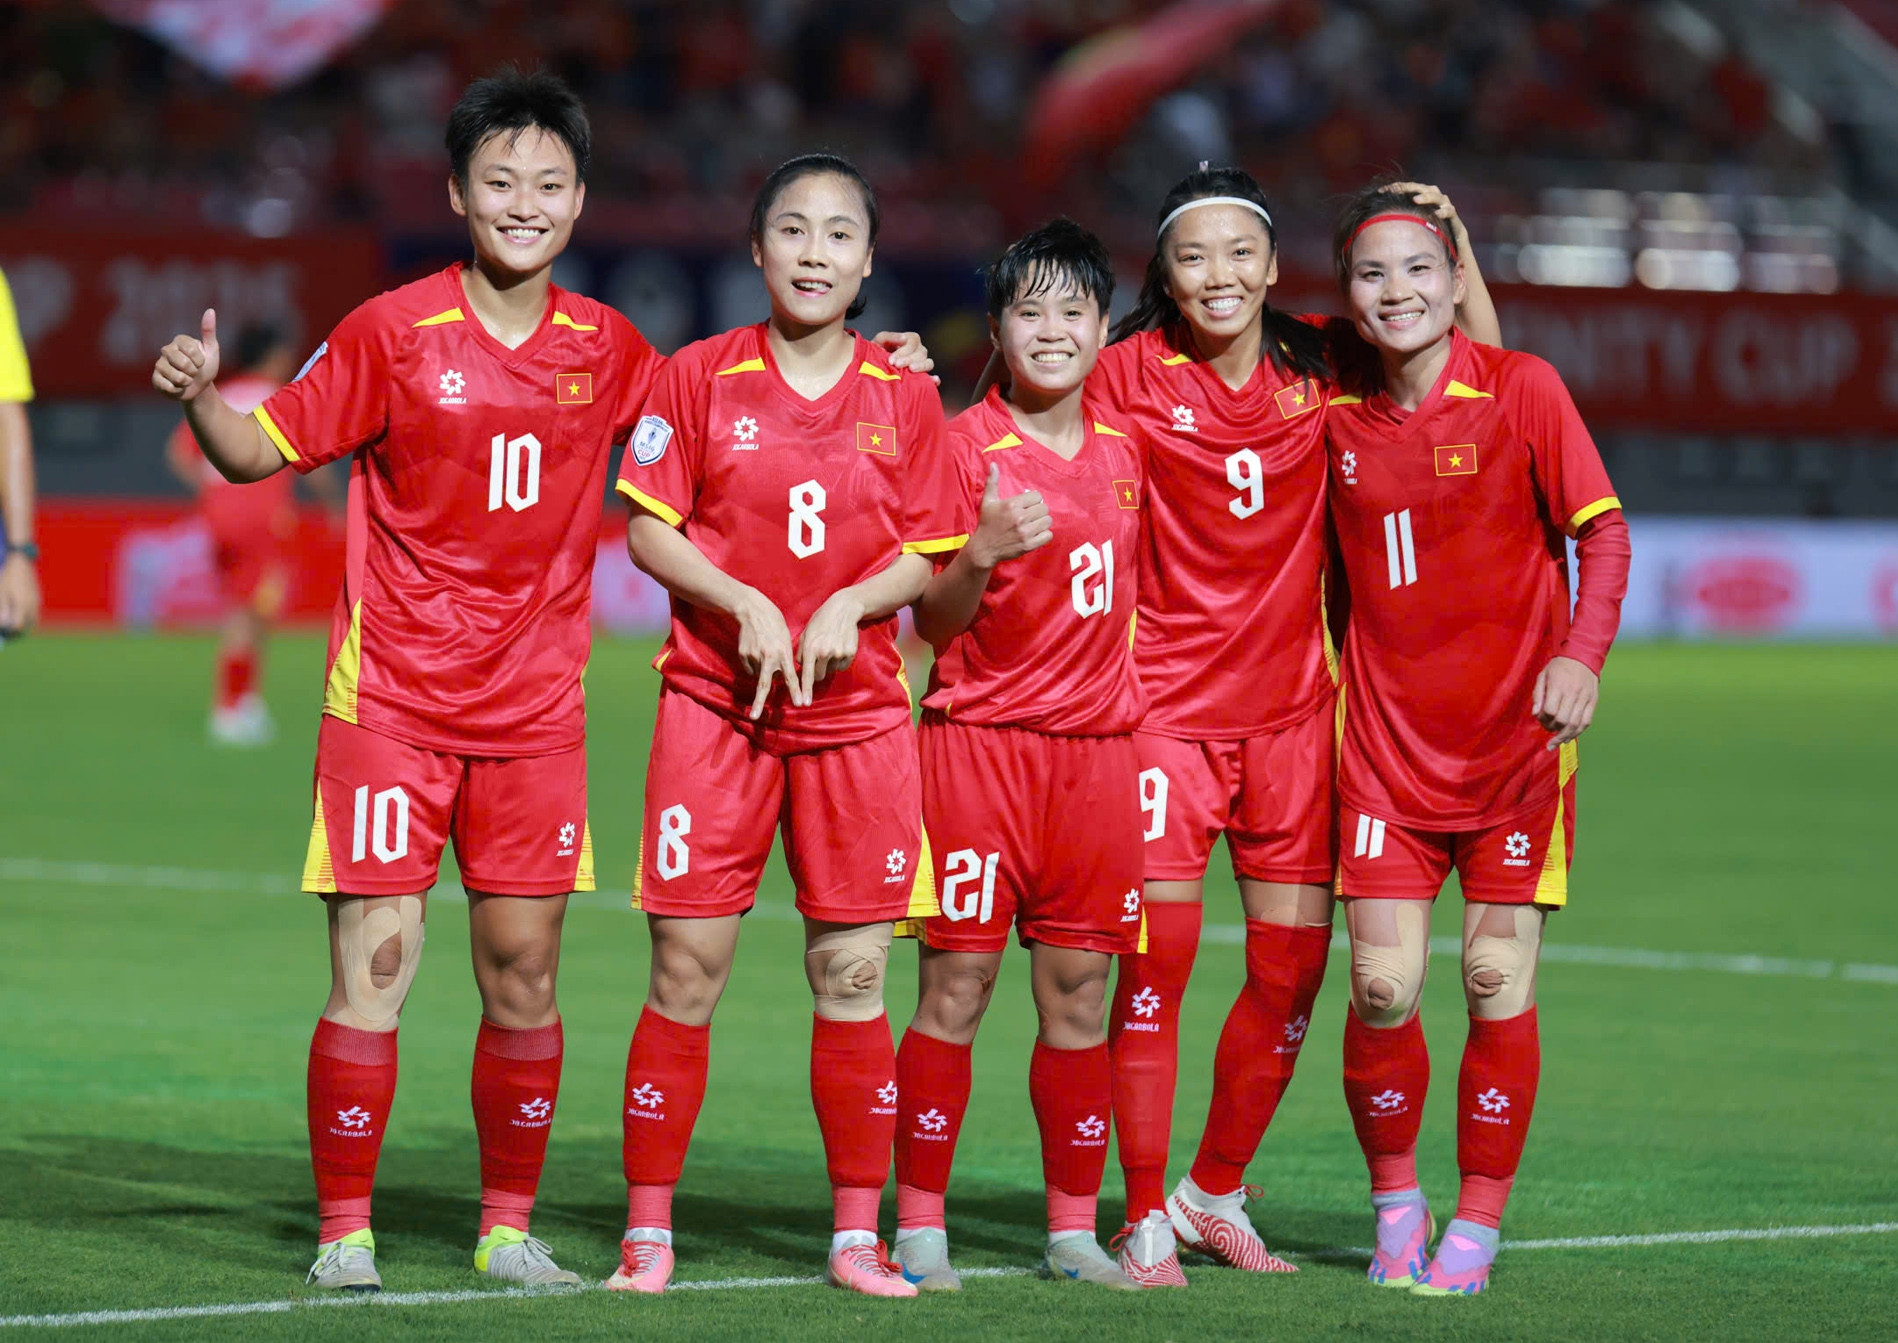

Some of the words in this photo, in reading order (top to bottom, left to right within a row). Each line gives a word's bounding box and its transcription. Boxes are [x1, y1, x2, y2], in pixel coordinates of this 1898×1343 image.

[488, 432, 542, 513] 10
[1224, 447, 1265, 520] 9
[787, 479, 827, 560] 8
[1383, 508, 1418, 591] 11
[1069, 538, 1115, 620] 21
[352, 784, 410, 865] 10
[657, 803, 692, 882] 8
[1139, 766, 1170, 844] 9
[1354, 813, 1387, 860] 11
[941, 848, 1000, 925] 21
